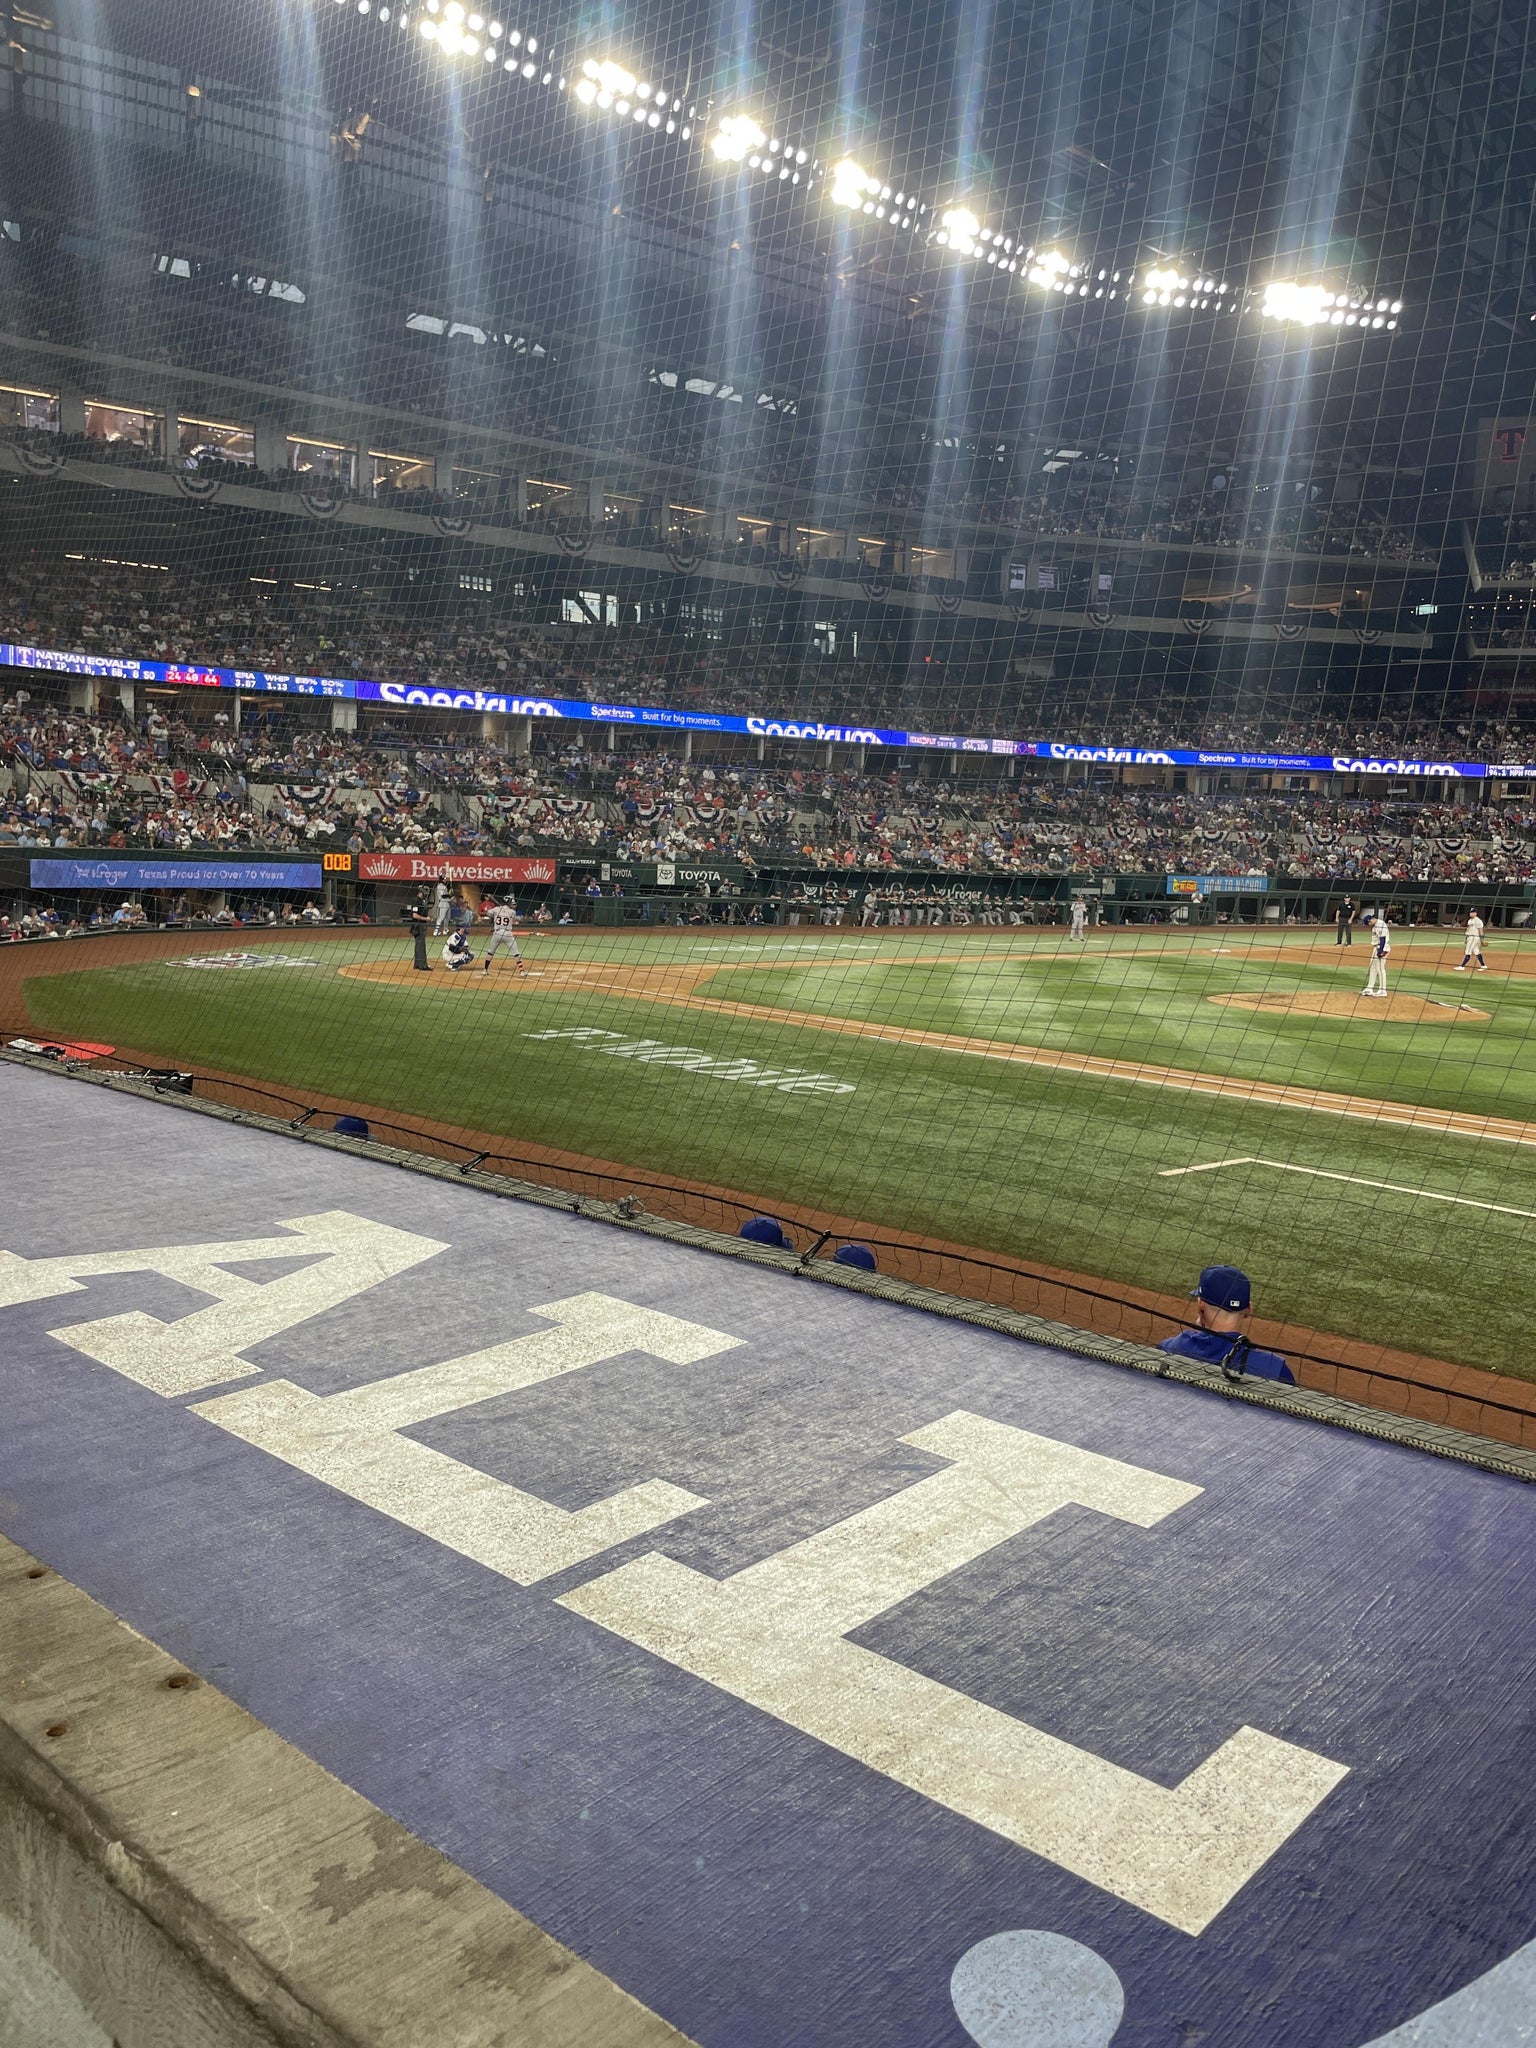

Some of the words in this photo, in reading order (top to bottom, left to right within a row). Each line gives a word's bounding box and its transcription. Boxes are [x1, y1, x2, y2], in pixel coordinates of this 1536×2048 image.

[35, 650, 85, 664] NATHAN
[86, 656, 141, 670] EOVALDI
[35, 659, 51, 669] 4.1
[56, 662, 70, 673] IP,
[85, 665, 95, 676] H,
[168, 671, 181, 681] 24
[204, 675, 218, 684] 64
[235, 671, 256, 680] ERA
[264, 674, 290, 683] WHIP
[591, 706, 634, 719] Spectrum
[642, 711, 659, 721] Built
[661, 712, 672, 722] for
[673, 713, 685, 725] big
[686, 716, 722, 727] moments.
[1199, 753, 1233, 765] Spectrum
[1242, 756, 1256, 764] Built
[1268, 757, 1278, 767] big
[1509, 769, 1524, 777] MPH
[92, 863, 128, 886] Kroger
[139, 869, 167, 879] Texas
[170, 869, 200, 879] Proud
[203, 870, 217, 879] for
[220, 870, 242, 879] Over
[245, 870, 257, 879] 70
[260, 871, 284, 880] Years
[410, 859, 512, 880] Budweiser
[611, 868, 632, 878] TOYOTA
[679, 870, 721, 881] TOYOTA
[495, 916, 510, 926] 39
